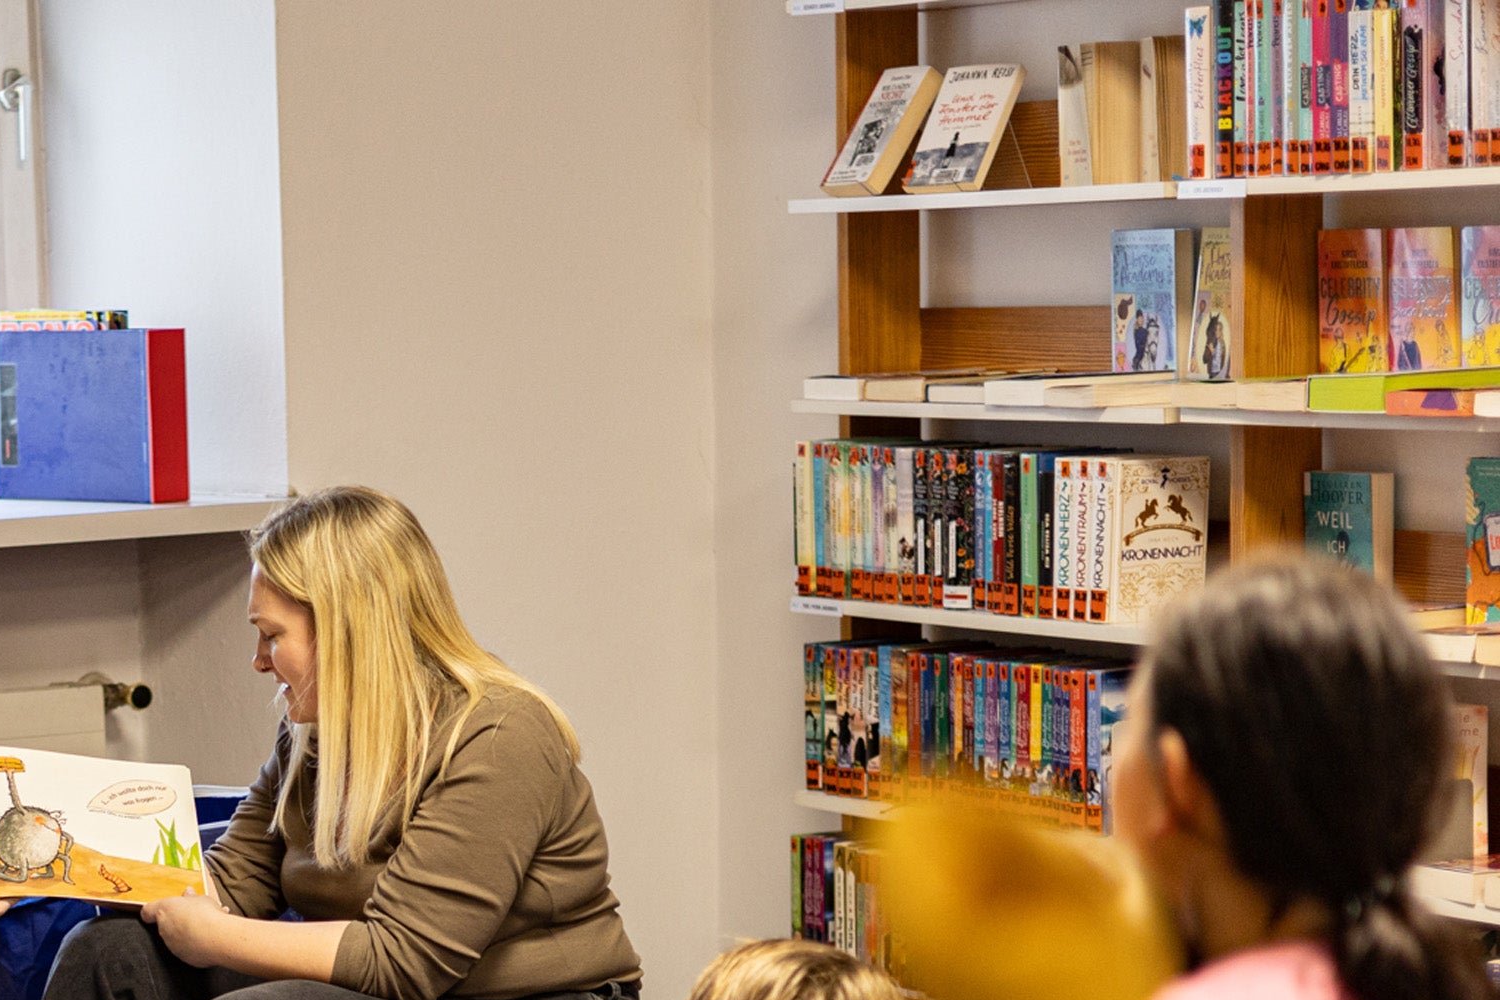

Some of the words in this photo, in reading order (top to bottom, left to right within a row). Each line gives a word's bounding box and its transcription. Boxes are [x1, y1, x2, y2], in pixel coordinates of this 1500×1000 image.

[1217, 26, 1233, 130] BLACKOUT
[1302, 67, 1310, 106] CASTING
[1317, 66, 1325, 105] CASTING
[1334, 63, 1343, 102] CASTING
[1352, 71, 1360, 91] DEIN
[1211, 247, 1231, 267] Hors
[1321, 277, 1381, 298] CELEBRITY
[1326, 293, 1377, 337] Gossip
[1311, 487, 1364, 505] HOOVER
[1316, 511, 1353, 529] WEIL
[1059, 494, 1070, 587] KRONENHERZ
[1076, 492, 1089, 588] KRONENTRAUM
[1094, 497, 1106, 589] KRONENNACHT
[1121, 544, 1203, 562] KRONENNACHT
[1326, 540, 1346, 553] ICH
